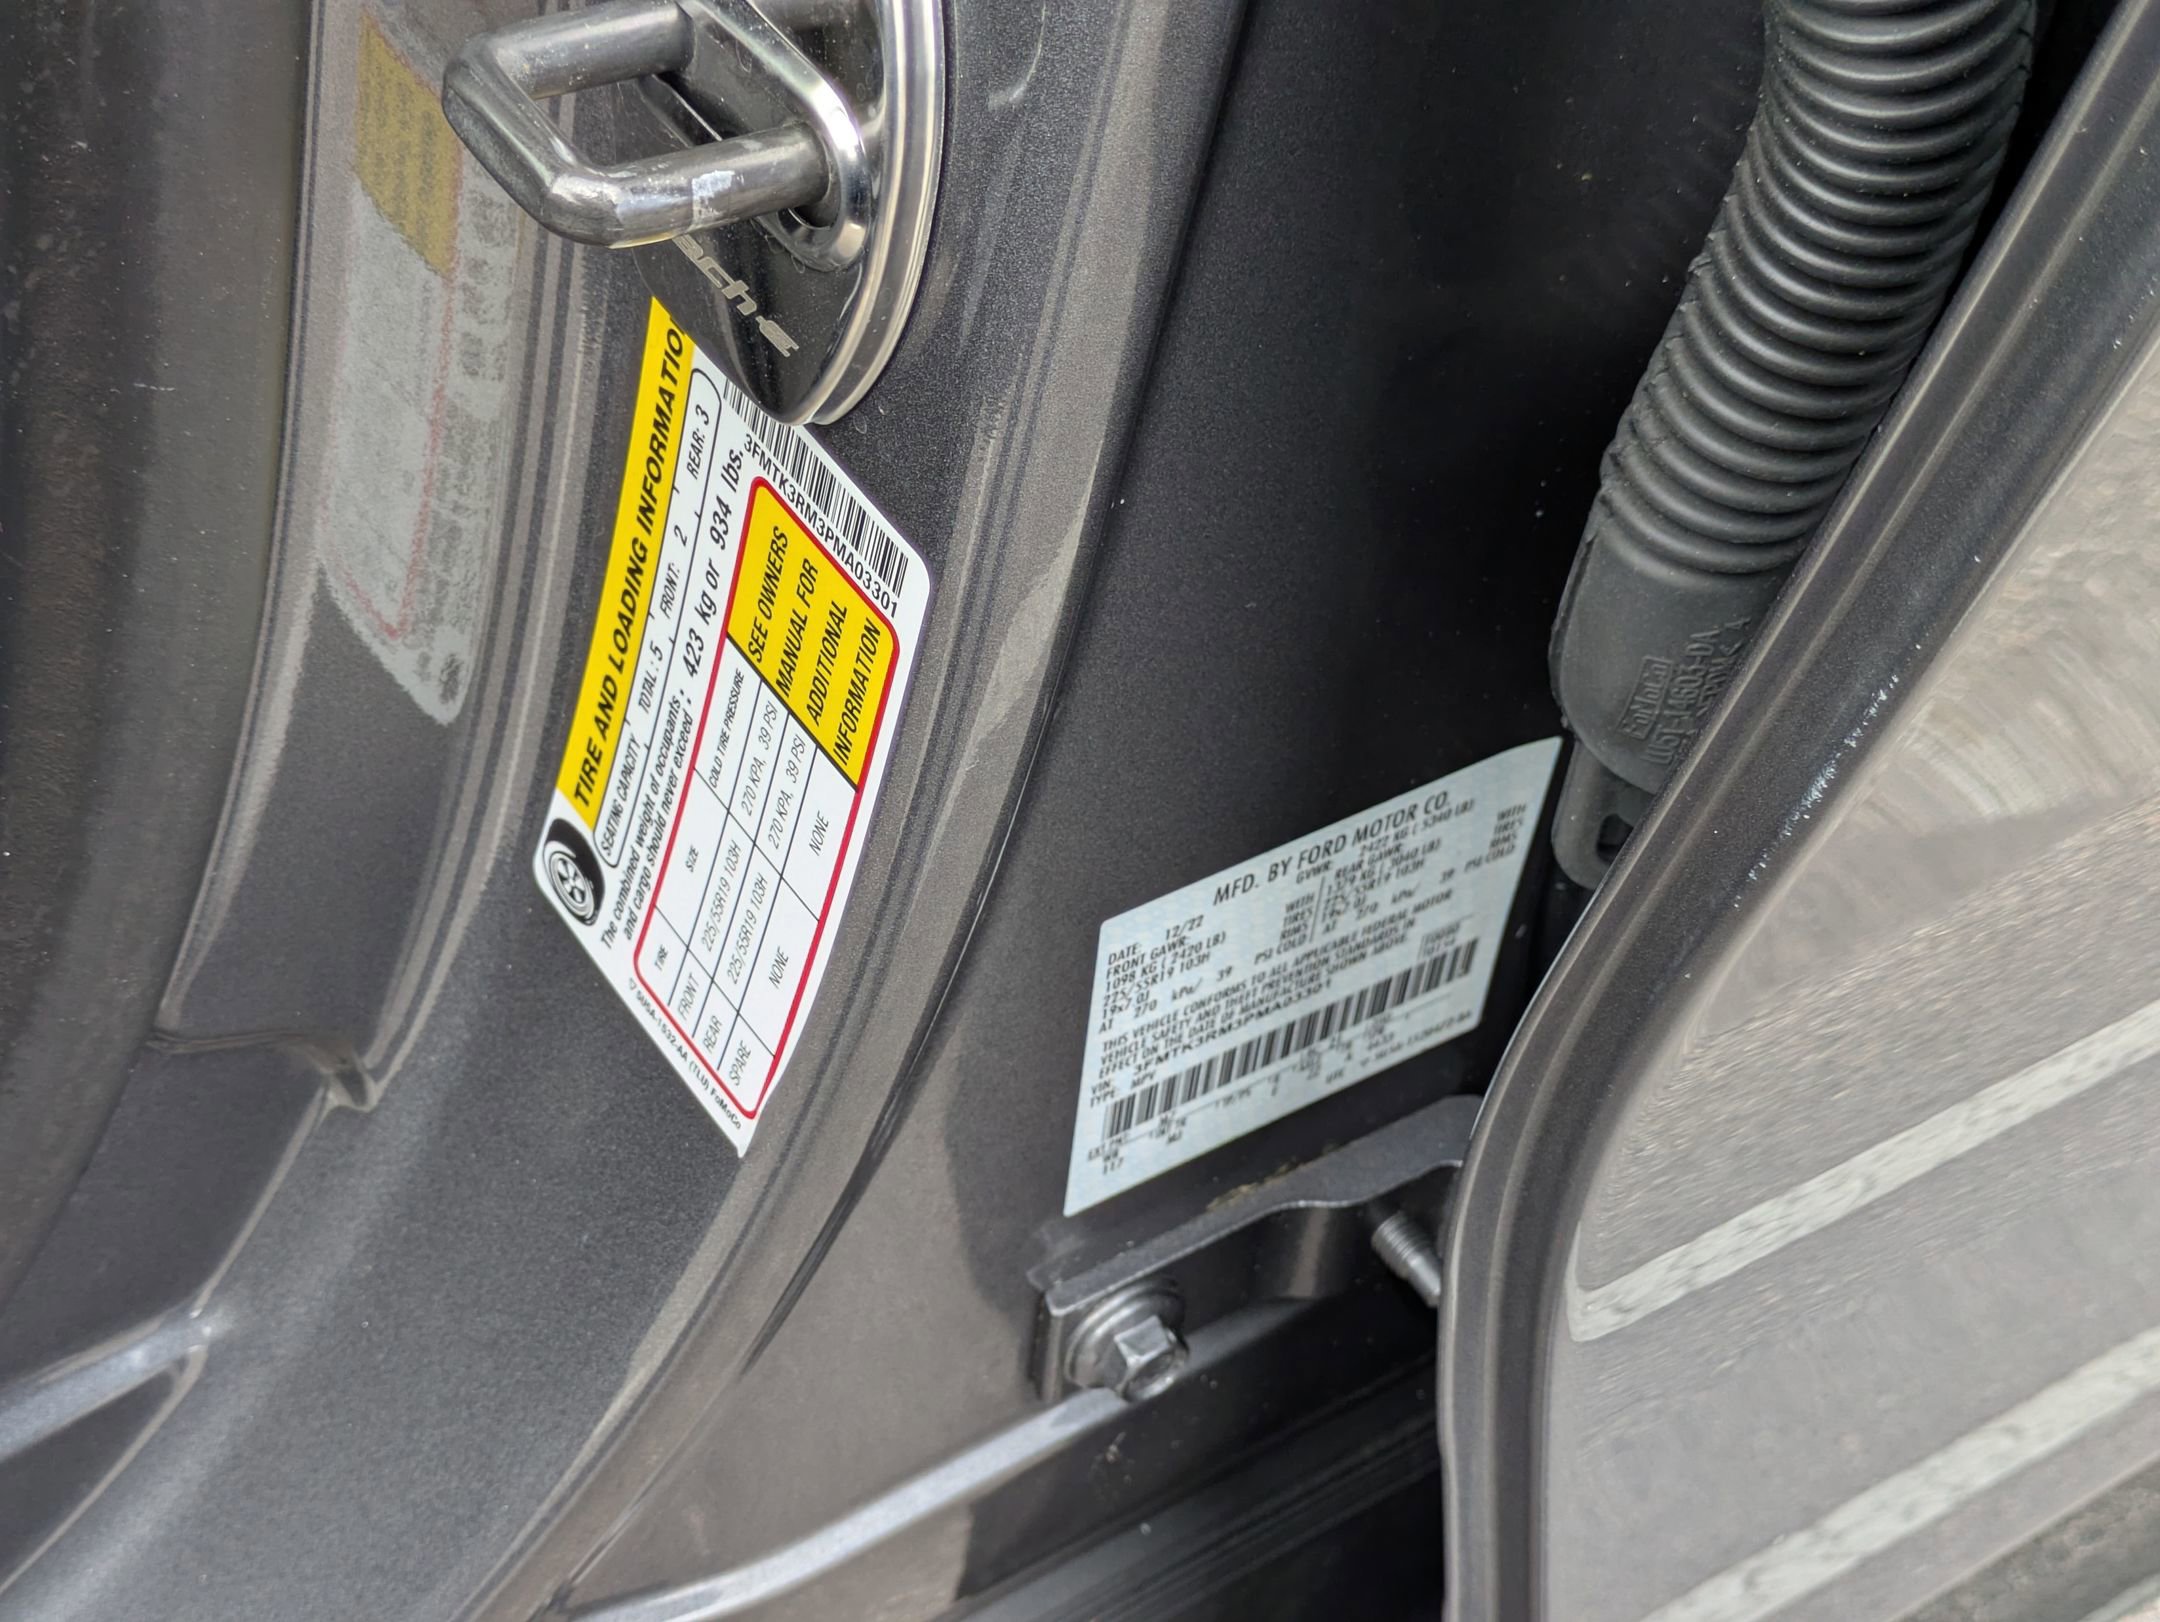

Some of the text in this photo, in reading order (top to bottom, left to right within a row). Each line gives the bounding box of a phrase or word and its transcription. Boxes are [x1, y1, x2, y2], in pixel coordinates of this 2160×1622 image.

[672, 233, 800, 358] ach-E
[694, 403, 710, 426] 3
[685, 426, 706, 480] REAR:
[719, 448, 744, 493] lbs.
[672, 523, 688, 547] 2
[708, 494, 732, 551] 934
[744, 433, 898, 618] 3FMTK3RM3PMA03301
[572, 315, 687, 807] TIRE AND LOADING INFORMATIO
[658, 561, 680, 619] FRONT:
[704, 557, 720, 591] or
[693, 589, 717, 626] kg
[746, 524, 788, 664] SEE OWNERS
[648, 639, 663, 662] 5
[681, 626, 704, 678] 423
[774, 556, 819, 698] MANUAL FOR
[805, 599, 848, 727] ADDITIONAL
[831, 616, 881, 766] INFORMATION
[615, 733, 640, 802] CAPACITY
[672, 707, 693, 769] exceed
[600, 694, 681, 949] The combined weight of occupants
[653, 667, 745, 970] TIRE SIZE COLD TIRE PRESSURE
[660, 767, 679, 815] never
[599, 797, 624, 857] SEATING
[645, 809, 667, 867] should
[1212, 786, 1453, 906] MFD. BY FORD MOTOR CO.
[1391, 824, 1410, 844] KG
[632, 864, 652, 911] cargo
[676, 699, 778, 1020] FRONT 225/55R19 103H 270 KPA, 39 PSI
[622, 905, 638, 941] and
[701, 732, 806, 1053] REAR 225/55R19 103H 270 KPA, 39 PSI
[728, 809, 829, 1087] SPARE NONE NONE
[1101, 1030, 1129, 1053] THIS
[1130, 1008, 1180, 1040] VEHICLE
[1182, 978, 1248, 1017] CONFORMS
[1250, 969, 1267, 987] TO
[1269, 959, 1290, 979] ALL
[1291, 929, 1358, 968] APPLICABLE
[1360, 907, 1409, 938] FEDERAL
[1410, 887, 1454, 916] MOTOR
[1104, 968, 1136, 995] 1098
[1139, 959, 1158, 979] KG
[1168, 940, 1203, 966] 2420
[1204, 929, 1227, 952] LB)
[1105, 951, 1146, 981] FRONT
[1106, 912, 1204, 967] DATE: 12/22
[1178, 948, 1211, 975] 103H
[1097, 1051, 1138, 1080] EFFECT
[1141, 1041, 1160, 1061] ON
[1163, 1030, 1185, 1050] THE
[1187, 1016, 1217, 1040] DATE
[1218, 1008, 1236, 1025] OF
[1237, 969, 1323, 1017] MANUFACTURE
[1324, 947, 1369, 977] SHOWN
[1098, 1015, 1115, 1035] AT
[1132, 997, 1158, 1019] 270
[1215, 964, 1233, 983] 39
[1099, 1035, 1147, 1067] VEHICLE
[1150, 1014, 1193, 1044] SAFETY
[1196, 1002, 1221, 1024] AND
[1224, 985, 1258, 1010] THEFT
[1260, 953, 1331, 994] PREVENTION
[1333, 922, 1401, 961] STANDARDS
[1401, 915, 1417, 932] IN
[1132, 976, 1333, 1077] 3FMTK3RM3PMA03301
[1129, 1069, 1157, 1090] MPV
